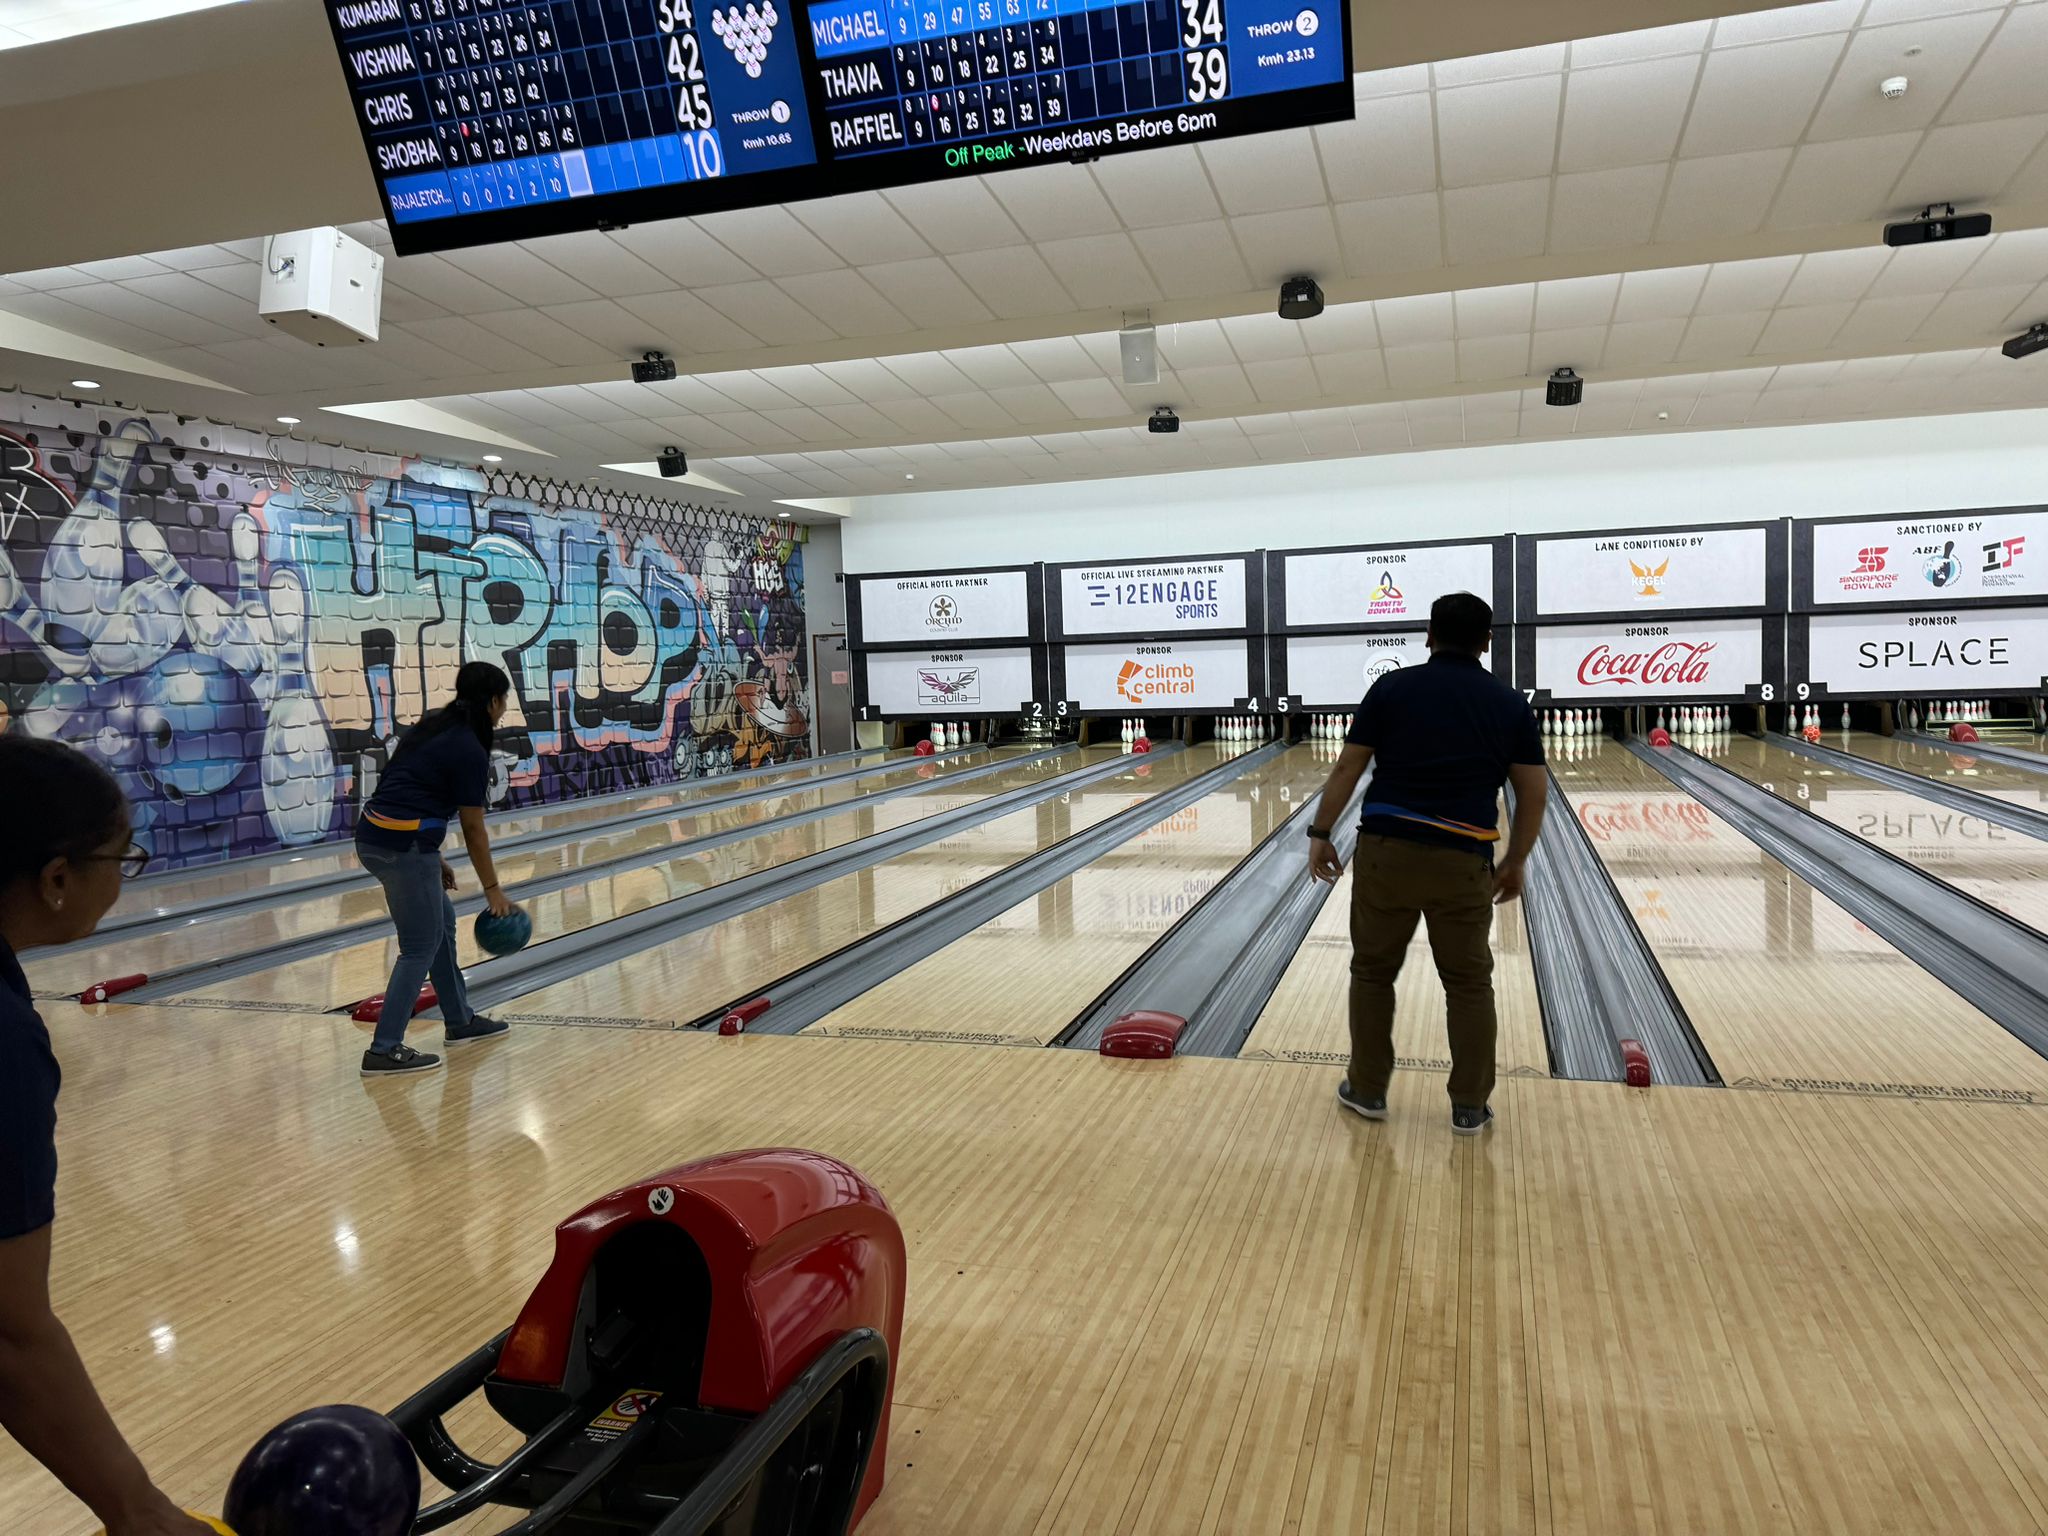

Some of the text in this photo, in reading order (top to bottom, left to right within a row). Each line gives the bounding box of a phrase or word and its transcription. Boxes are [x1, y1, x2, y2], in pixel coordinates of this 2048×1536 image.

[336, 0, 402, 29] KUMARAN
[812, 9, 886, 47] MICHAEL
[898, 16, 908, 35] 9
[923, 11, 938, 31] 29
[951, 6, 964, 26] 47
[978, 1, 993, 22] 55
[1006, 0, 1020, 16] 63
[1048, 20, 1056, 36] 9
[1247, 19, 1294, 39] THROW
[349, 42, 416, 79] VISHWA
[445, 46, 459, 65] 12
[513, 33, 529, 53] 26
[658, 0, 693, 34] 34
[820, 0, 1224, 99] THAVA 9 10 18 22 25 34 34
[1257, 46, 1317, 68] Kmh 23.13
[364, 91, 414, 127] CHRIS
[435, 98, 448, 116] 14
[480, 90, 493, 109] 27
[502, 86, 517, 105] 33
[527, 82, 541, 101] 42
[666, 33, 704, 82] 42
[829, 47, 1228, 149] RAFFIEL 9 16 25 32 32 39 39
[731, 107, 771, 125] THROW
[376, 136, 442, 171] SHOBHA
[449, 145, 459, 162] 9
[492, 137, 507, 156] 22
[561, 126, 575, 144] 45
[677, 83, 713, 131] 45
[742, 136, 767, 151] Kmh
[944, 145, 969, 168] Off
[973, 140, 1017, 163] Peak
[1115, 116, 1174, 142] Before
[1176, 110, 1218, 133] 6pm
[506, 184, 516, 201] 2
[530, 181, 539, 198] 2
[550, 177, 562, 195] 10
[683, 129, 722, 180] 10
[1896, 521, 1983, 536] SANCTIONED BY
[1594, 536, 1704, 552] LANE CONDITIONED BY
[1912, 544, 1942, 556] ABF
[1366, 554, 1407, 566] SPONSOR
[1080, 564, 1225, 581] OFFICIAL LIVE STREAMING PARTNER
[1631, 575, 1666, 586] KEGEL
[1838, 573, 1900, 584] SINGAPORE
[896, 577, 989, 591] OFFICIAL HOTEL PARTNER
[1114, 579, 1218, 605] 12ENGAGE
[1842, 581, 1893, 591] BOWLING
[1175, 603, 1219, 620] SPORTS
[924, 616, 963, 628] ORCHID
[1908, 616, 1958, 627] SPONSOR
[1625, 626, 1670, 638] SPONSOR
[1366, 637, 1407, 648] SPONSOR
[930, 653, 964, 664] SPONSOR
[1136, 646, 1173, 656] SPONSOR
[1857, 637, 2010, 670] SPLACE
[1144, 663, 1195, 680] climb
[1577, 641, 1718, 686] Coca-Cola
[1133, 678, 1195, 695] central
[1760, 682, 1775, 701] 8
[1796, 682, 1810, 701] 9
[930, 690, 969, 705] aquila
[1522, 688, 1537, 704] 7
[1031, 702, 1043, 718] 2
[1056, 700, 1068, 716] 3
[1247, 697, 1259, 713] 4
[1277, 696, 1289, 713] 5
[859, 706, 869, 721] 1
